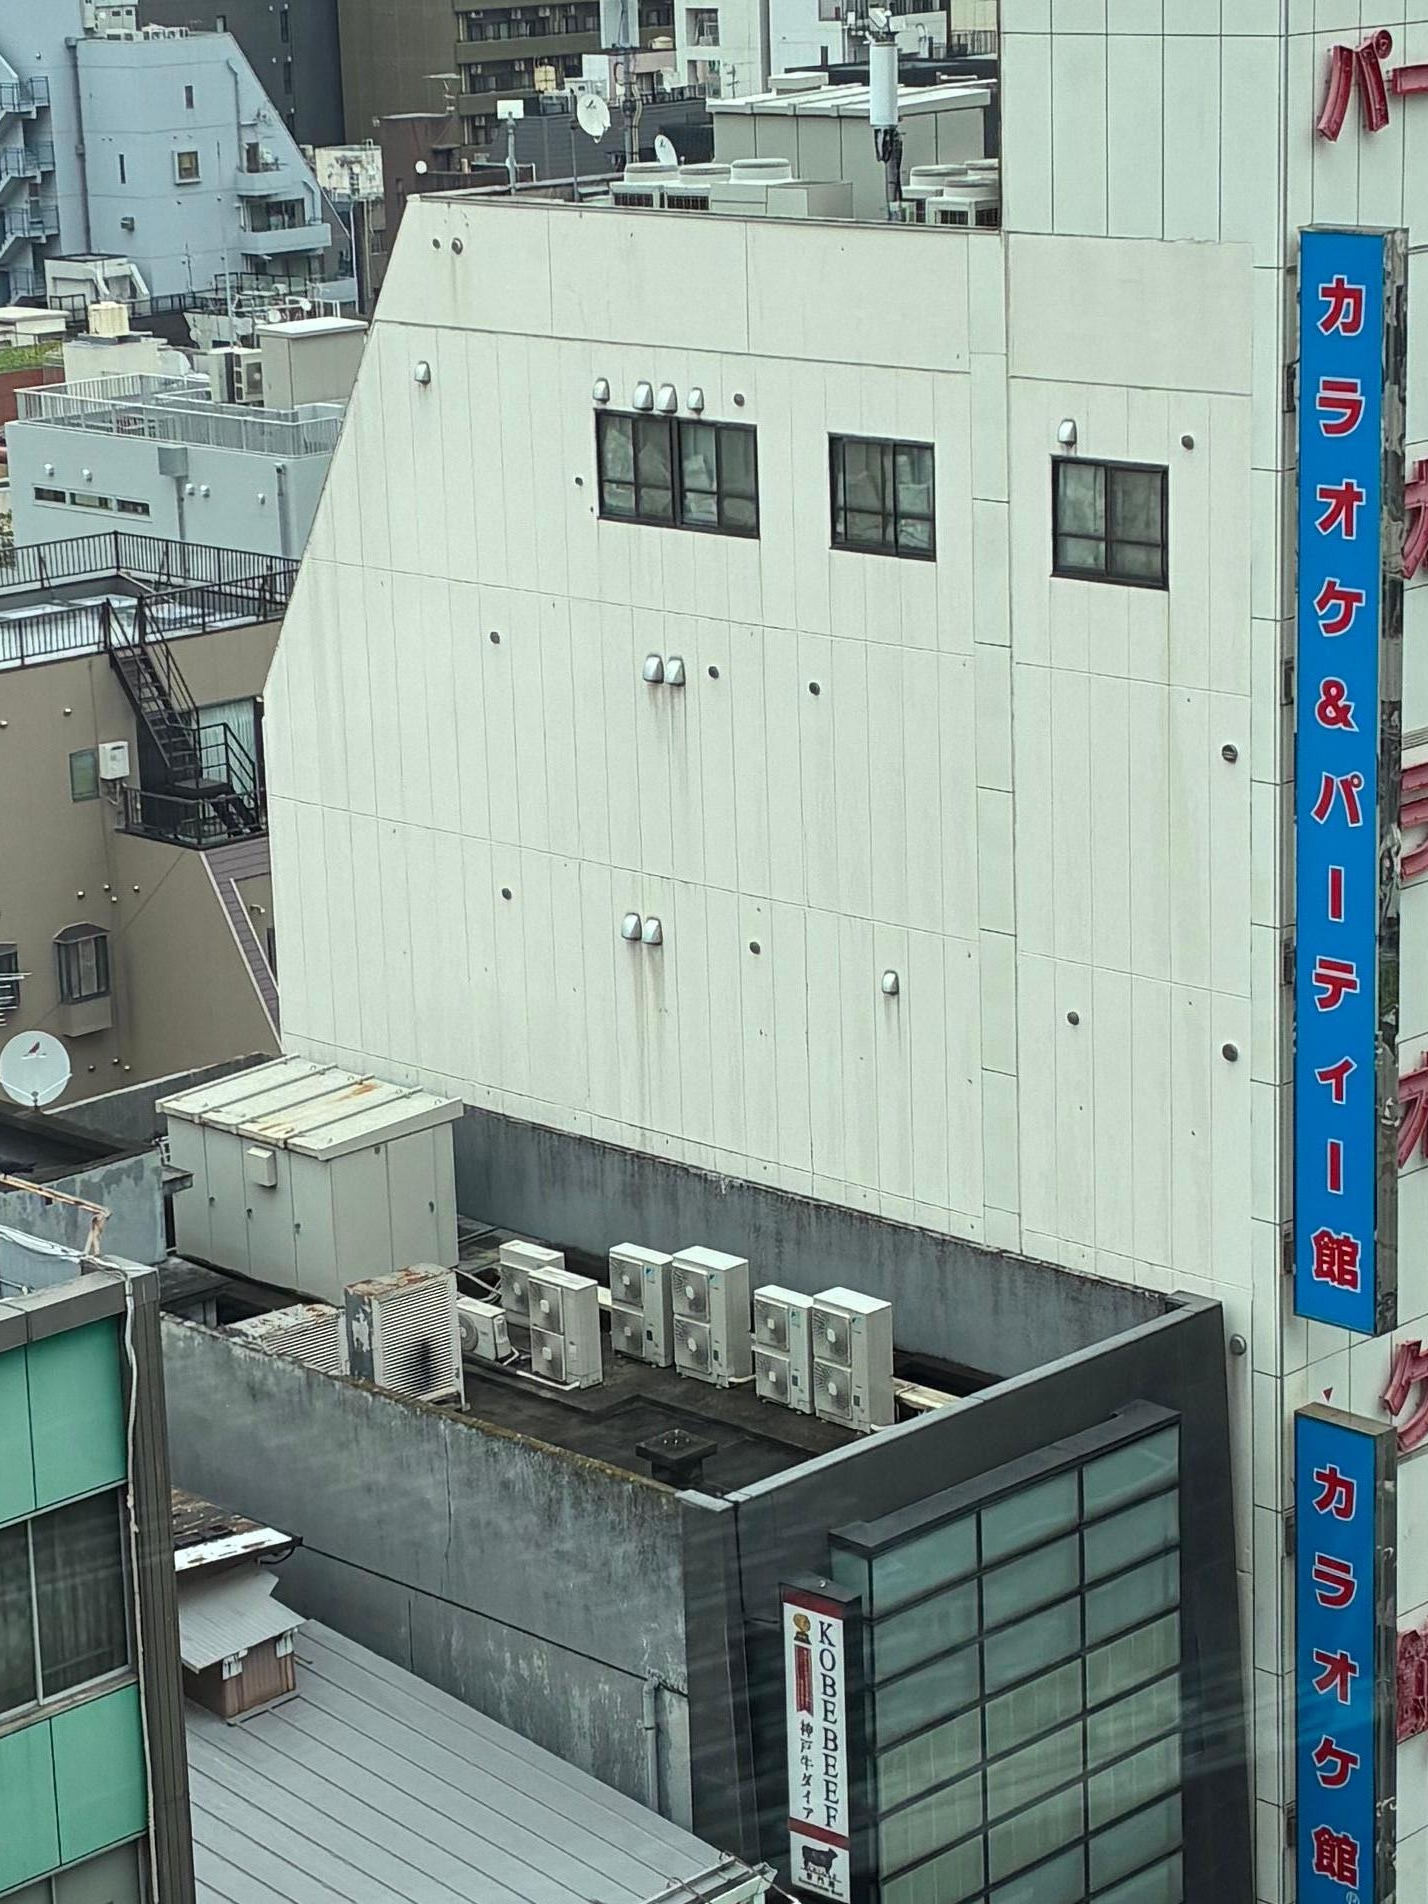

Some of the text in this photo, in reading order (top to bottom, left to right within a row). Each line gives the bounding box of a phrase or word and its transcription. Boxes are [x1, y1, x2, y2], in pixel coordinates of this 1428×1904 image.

[1310, 1463, 1362, 1893] カラオケ館
